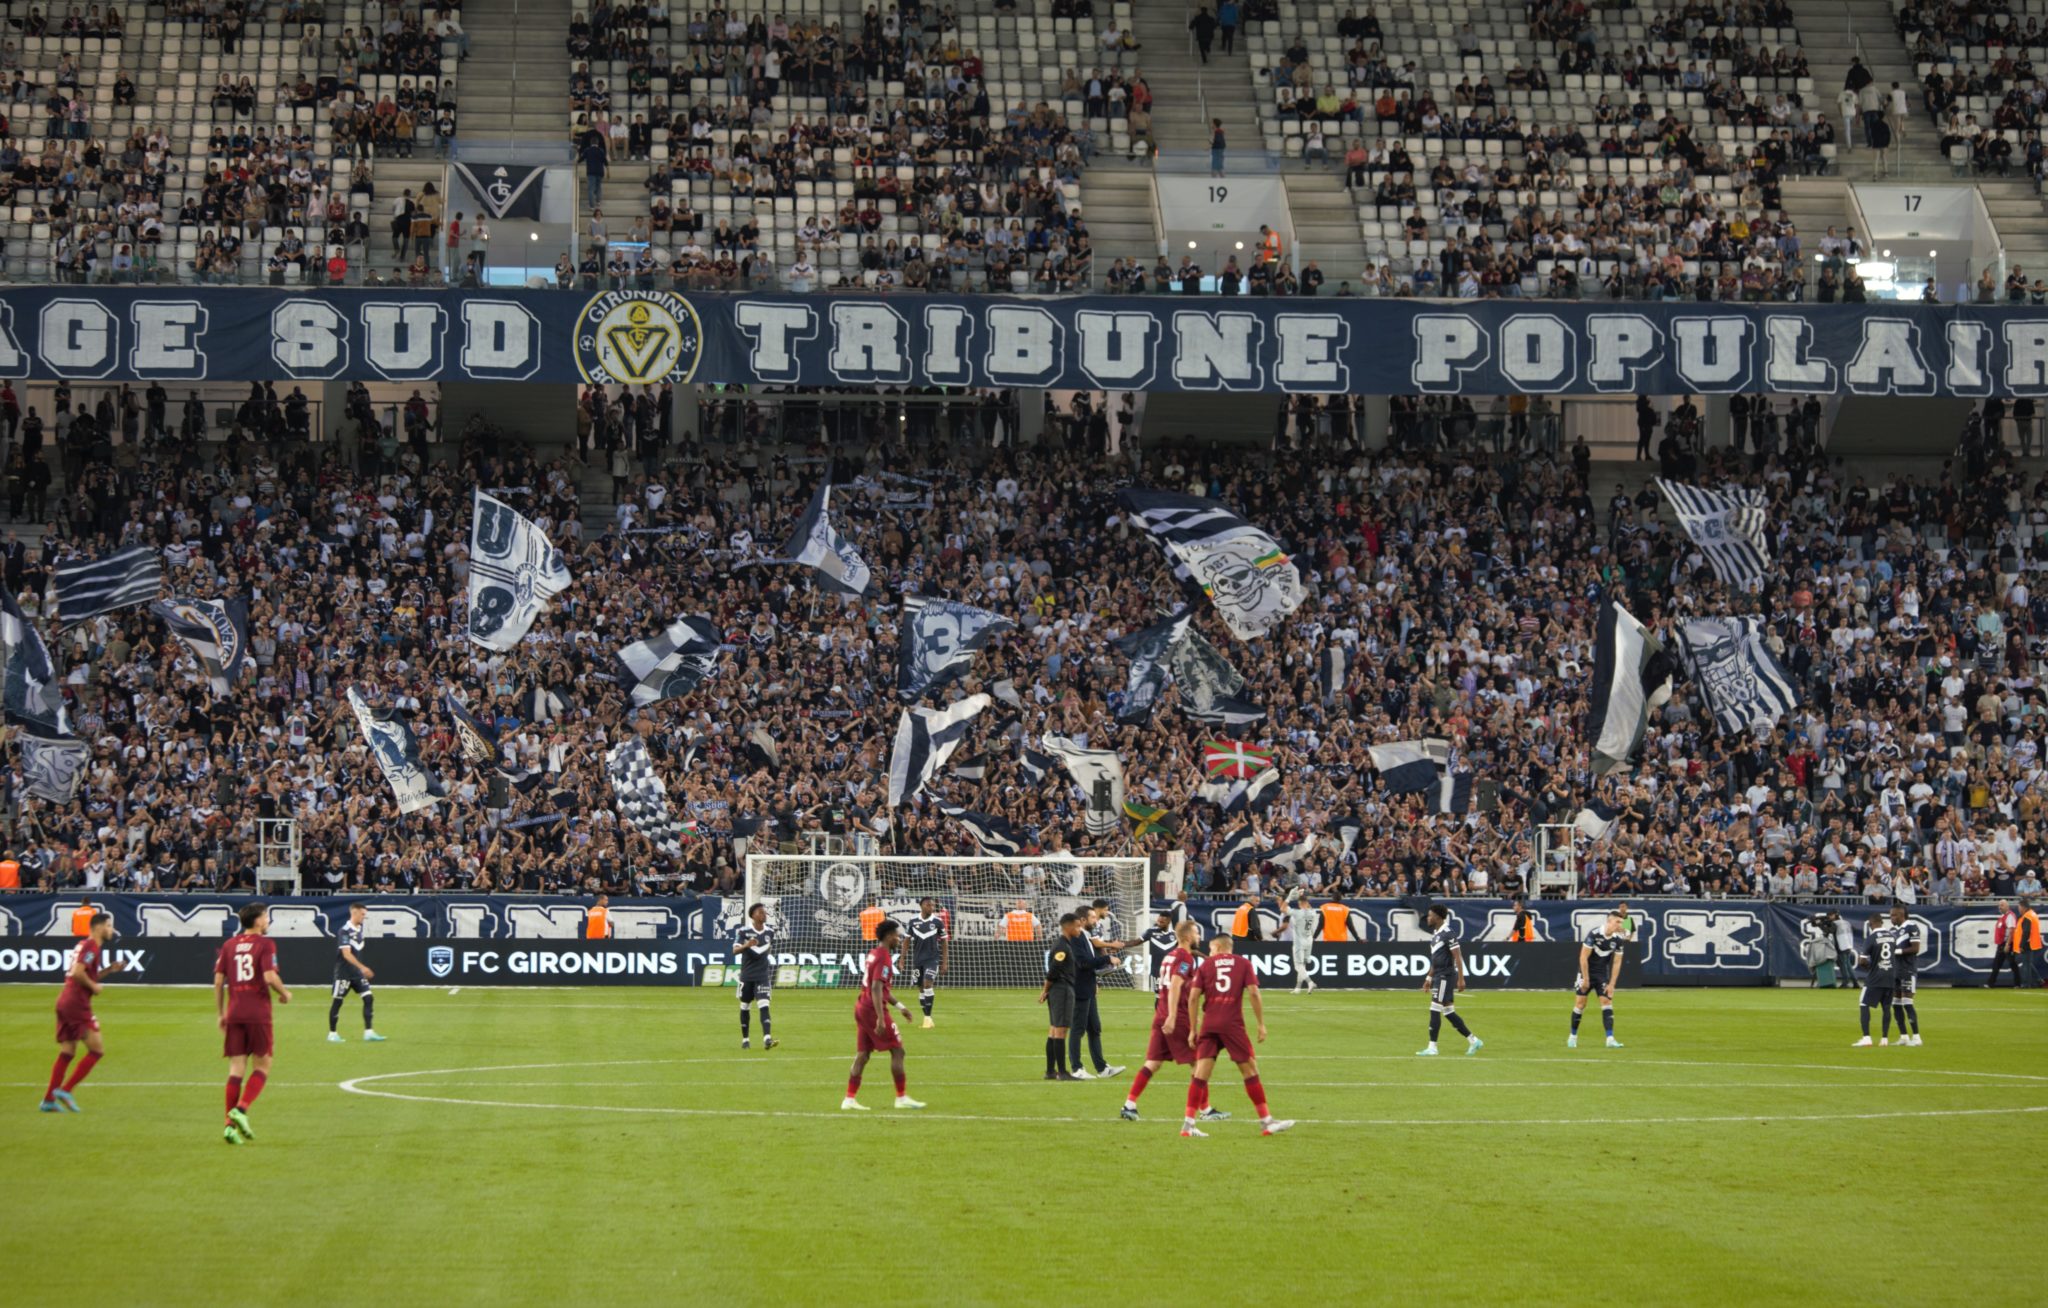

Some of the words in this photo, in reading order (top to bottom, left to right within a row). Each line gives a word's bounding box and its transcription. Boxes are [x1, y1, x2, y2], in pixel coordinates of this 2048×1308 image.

[1208, 186, 1228, 203] 19
[1904, 195, 1922, 212] 17
[588, 290, 689, 323] GIRONDINS
[0, 297, 209, 381] GE
[271, 297, 541, 381] SUD
[734, 299, 1350, 393] TRIBUNE
[462, 951, 500, 974] FC
[508, 951, 678, 974] GIRONDINS
[1880, 942, 1892, 960] 8
[234, 954, 255, 982] 13
[703, 969, 741, 983] BK
[777, 969, 840, 983] BKT
[1215, 967, 1232, 993] 5
